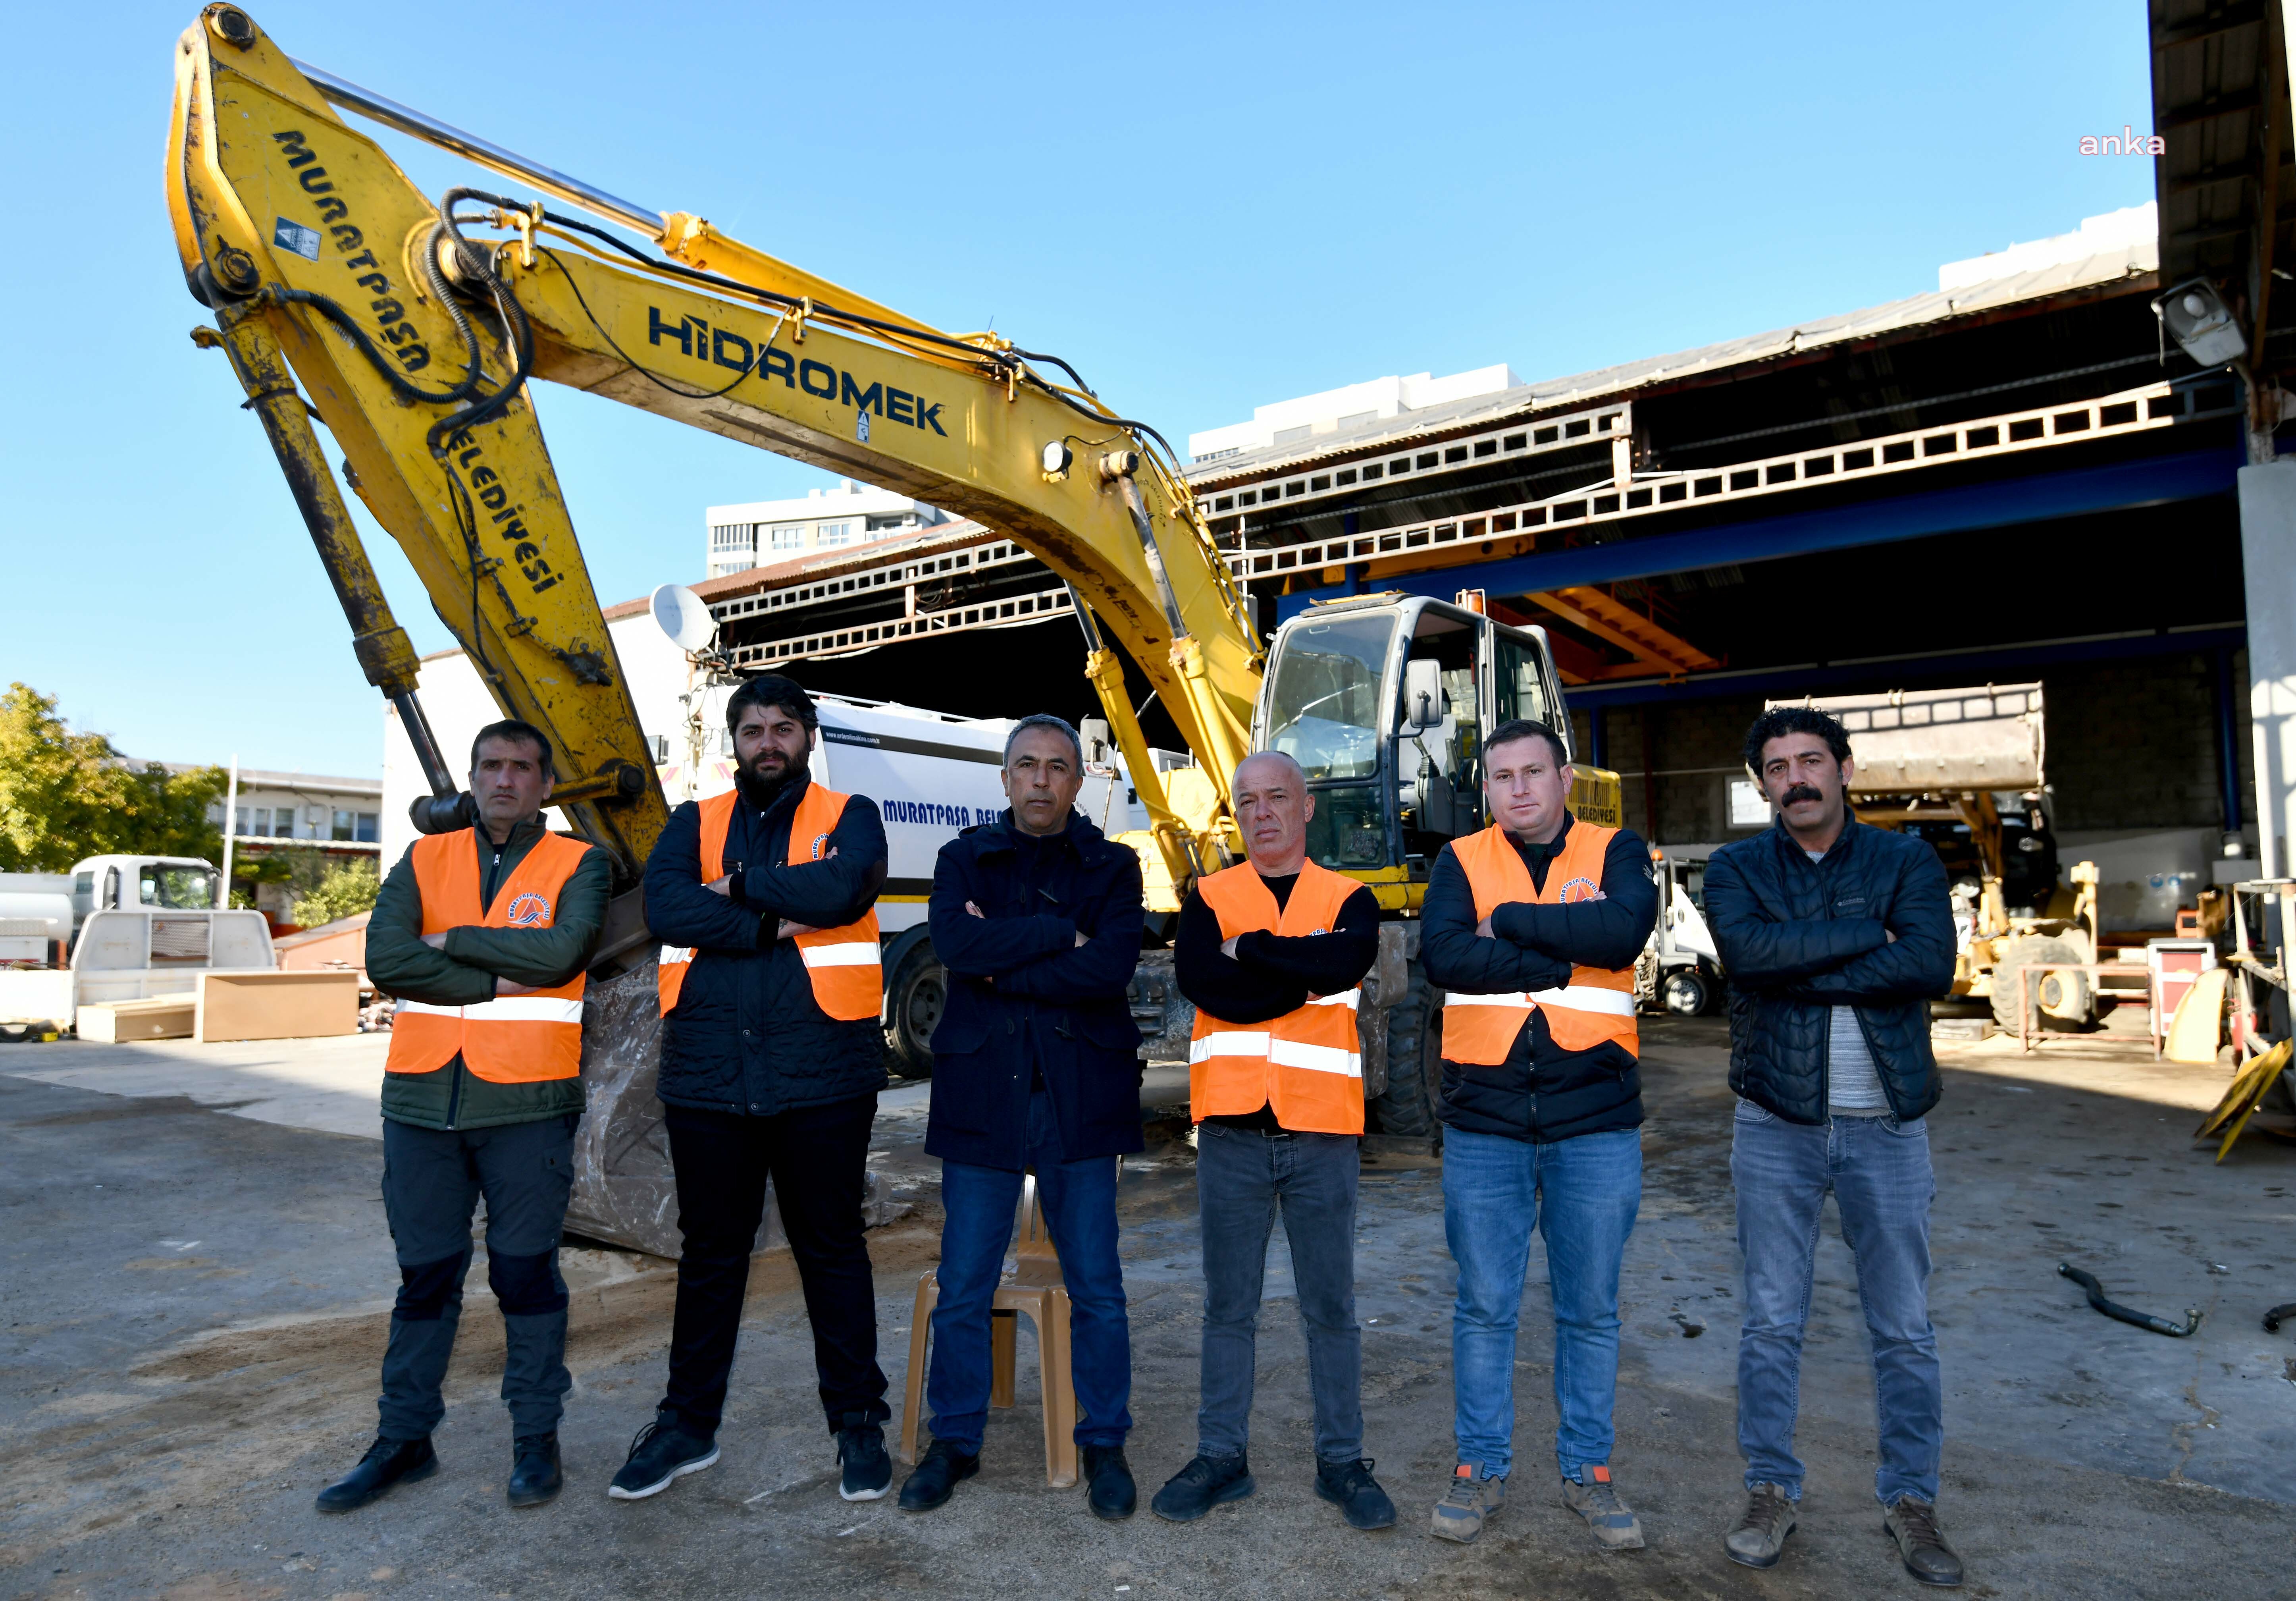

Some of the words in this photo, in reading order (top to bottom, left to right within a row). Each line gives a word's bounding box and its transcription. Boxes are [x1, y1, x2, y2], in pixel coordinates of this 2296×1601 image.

[449, 428, 564, 594] ELEDİYESİ
[826, 732, 880, 744] www.erdemlimakina.com.tr
[883, 799, 970, 831] MURATPAŞA
